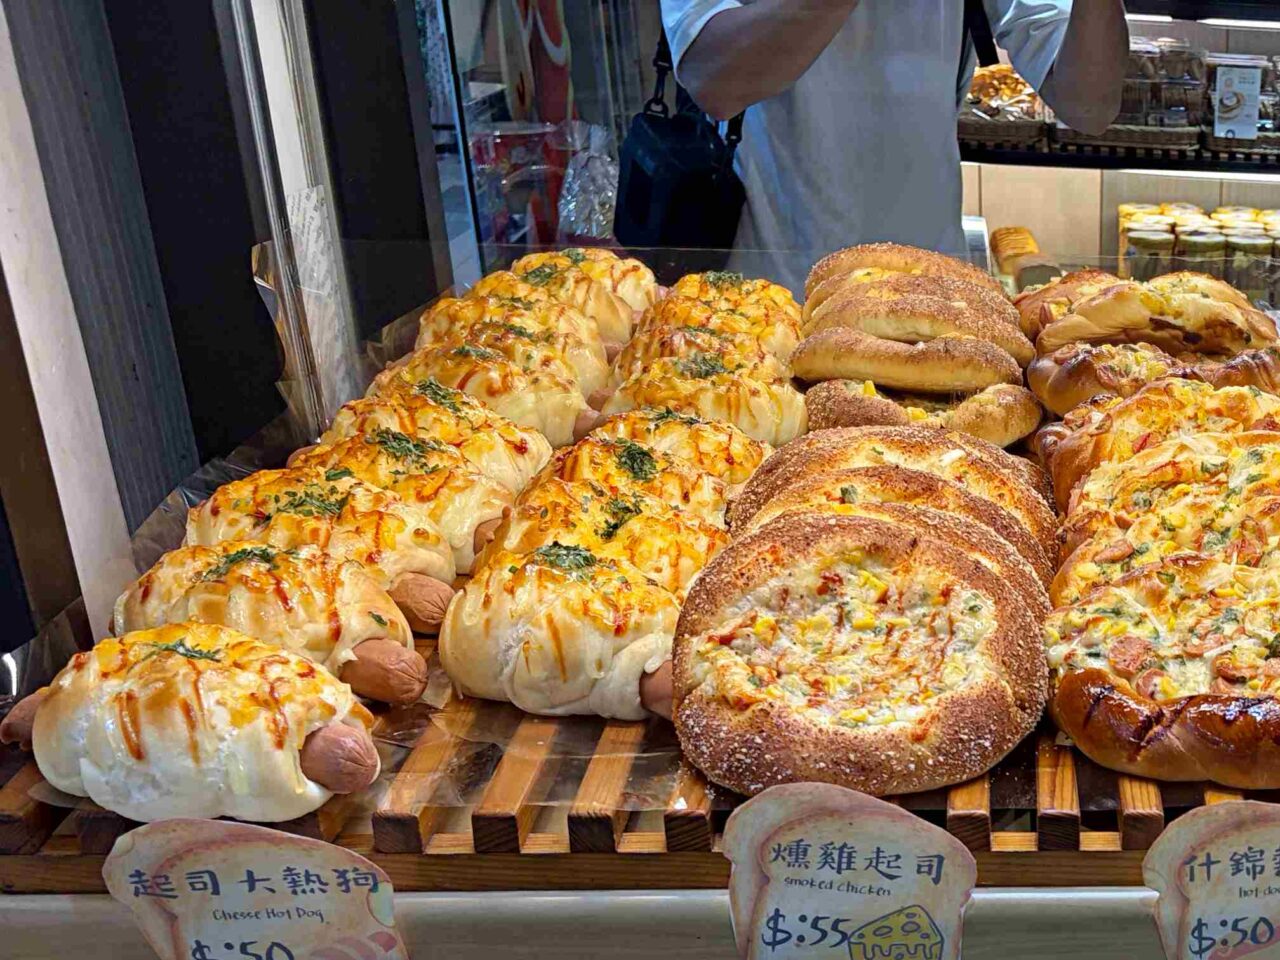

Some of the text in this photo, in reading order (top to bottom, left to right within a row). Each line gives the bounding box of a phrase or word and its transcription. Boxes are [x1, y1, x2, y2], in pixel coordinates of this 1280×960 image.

[769, 838, 945, 886] 燻雞起司
[127, 866, 379, 900] 起司大熱狗
[783, 876, 893, 896] smoked chicken
